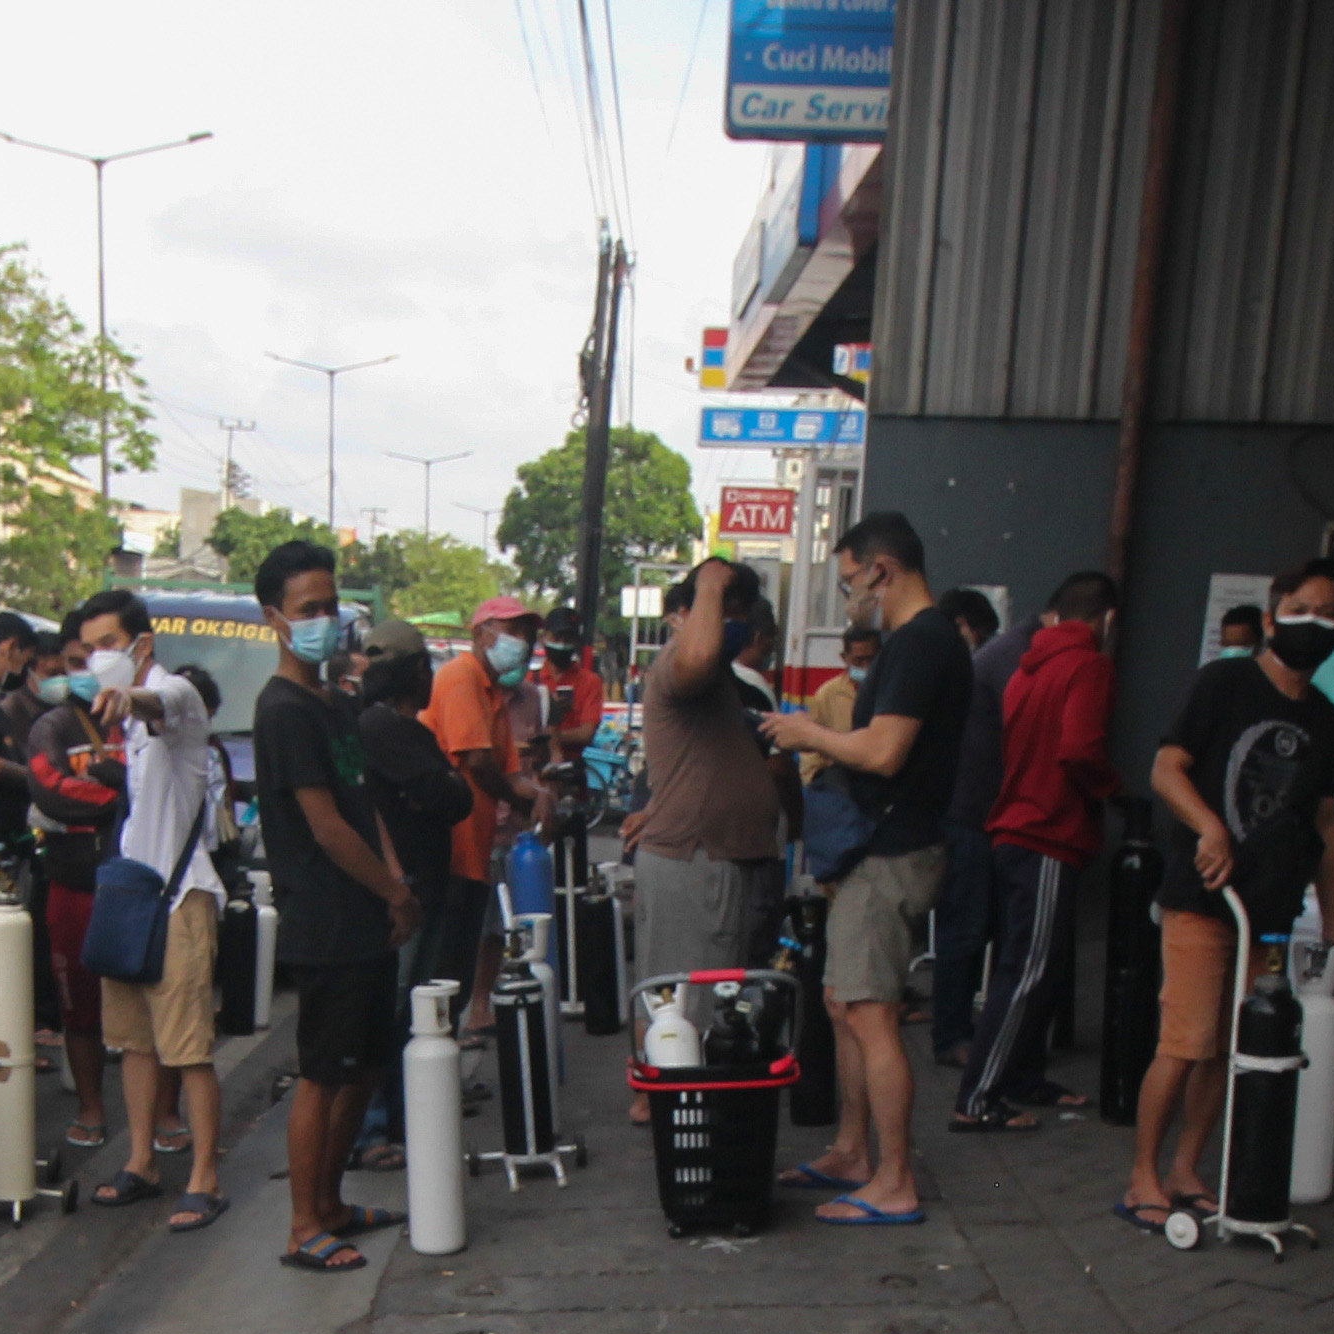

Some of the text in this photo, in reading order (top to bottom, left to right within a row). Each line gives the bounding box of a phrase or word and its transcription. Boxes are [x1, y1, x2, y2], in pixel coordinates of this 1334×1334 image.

[762, 42, 893, 73] Cuci Mobil
[741, 91, 794, 119] Car
[728, 503, 786, 530] ATM
